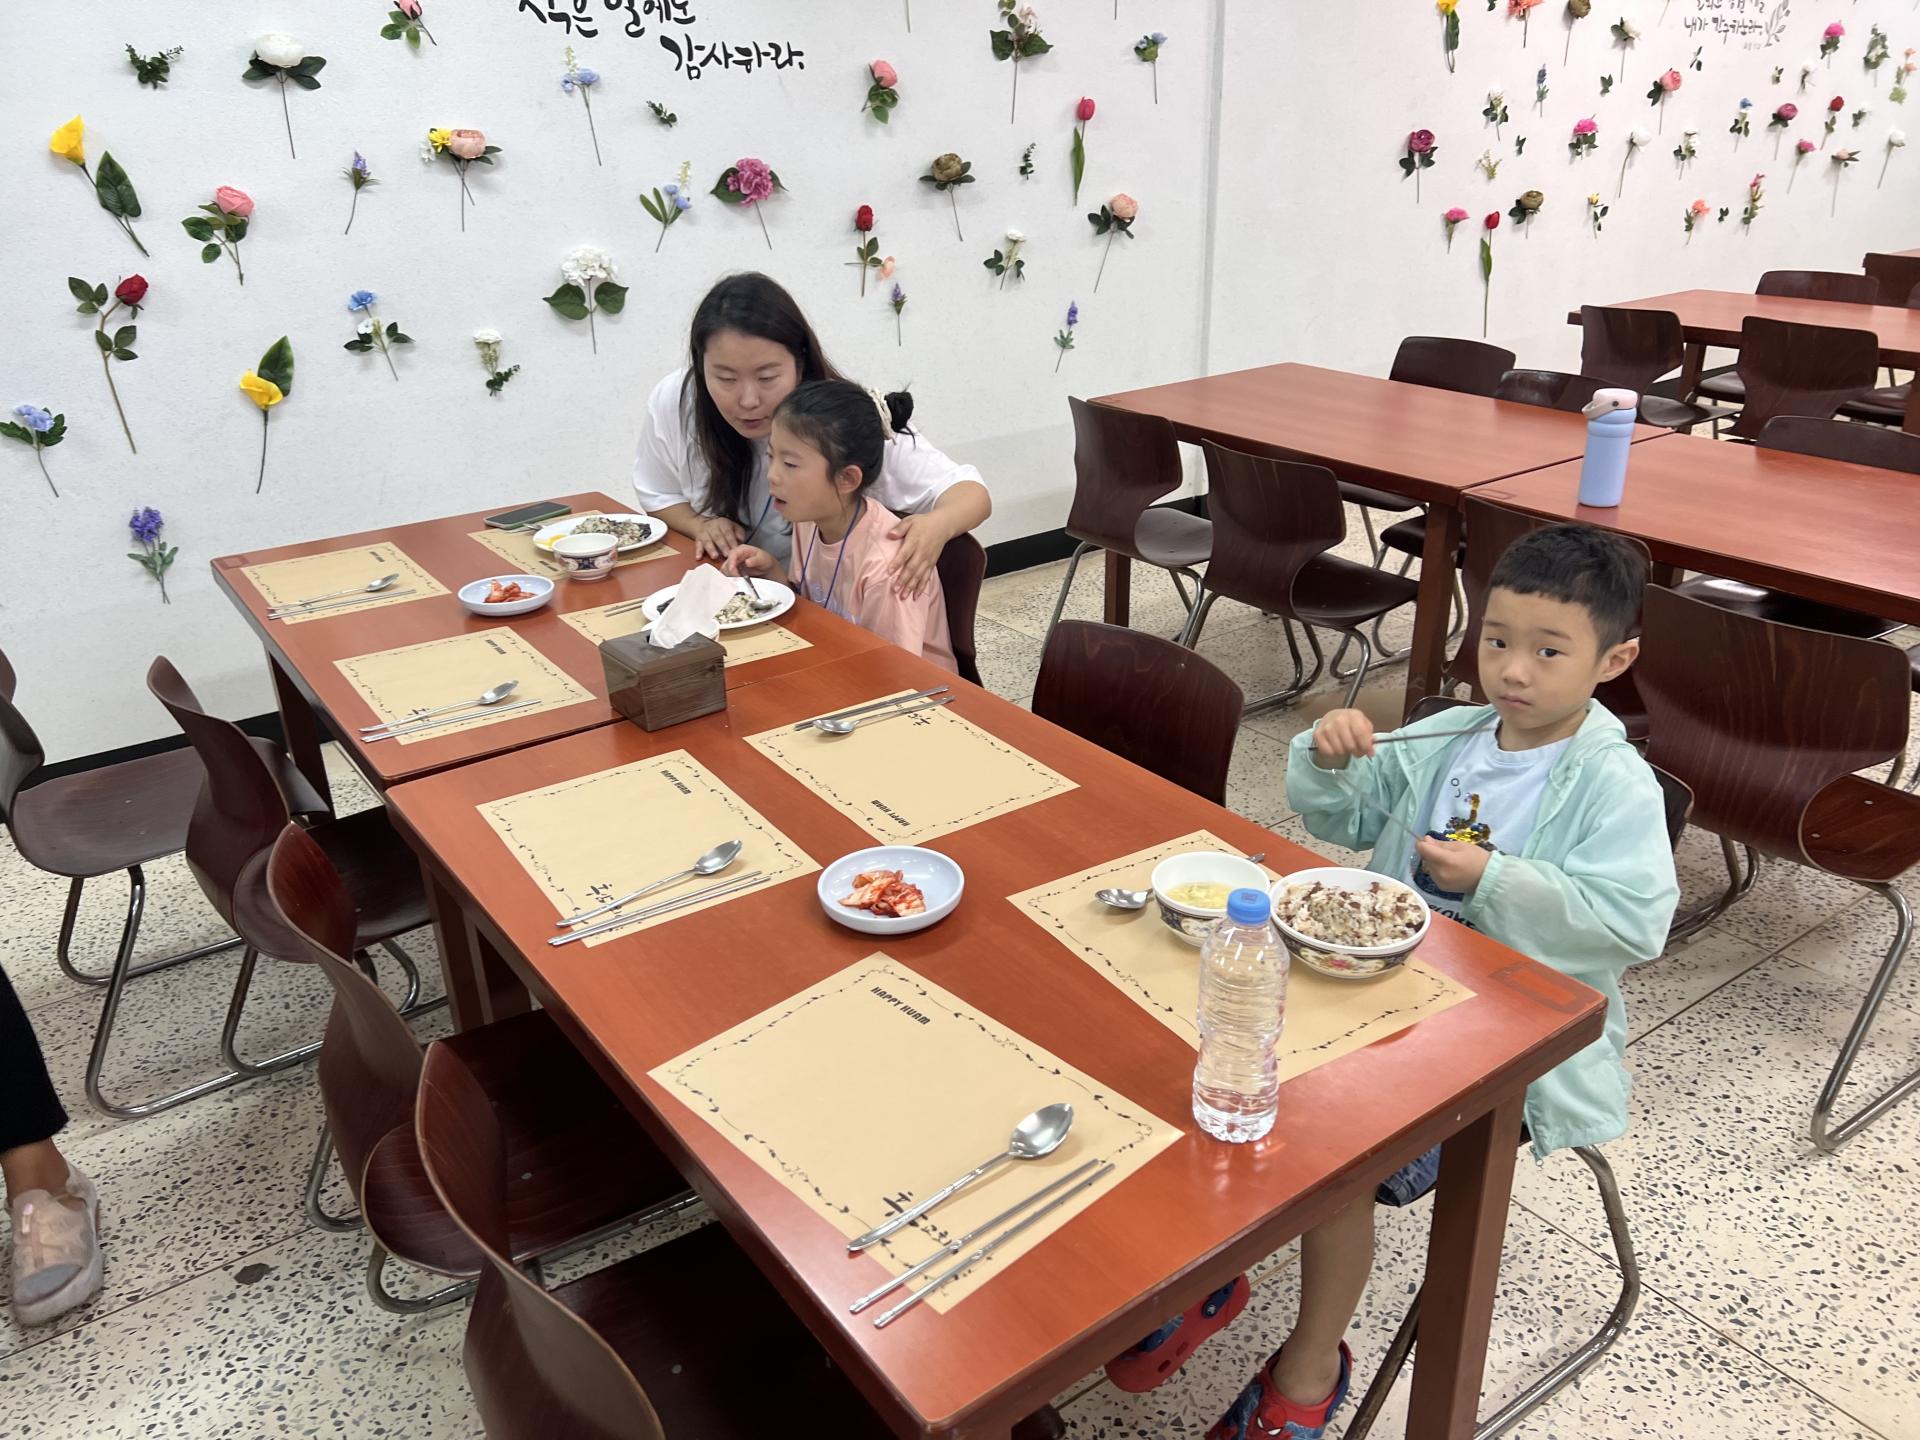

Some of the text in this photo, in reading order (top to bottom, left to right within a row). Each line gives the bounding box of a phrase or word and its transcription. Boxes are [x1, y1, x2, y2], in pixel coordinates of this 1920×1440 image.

[1684, 16, 1709, 38] 내가
[660, 33, 805, 81] 감사하라.
[870, 986, 904, 1007] HAPPY
